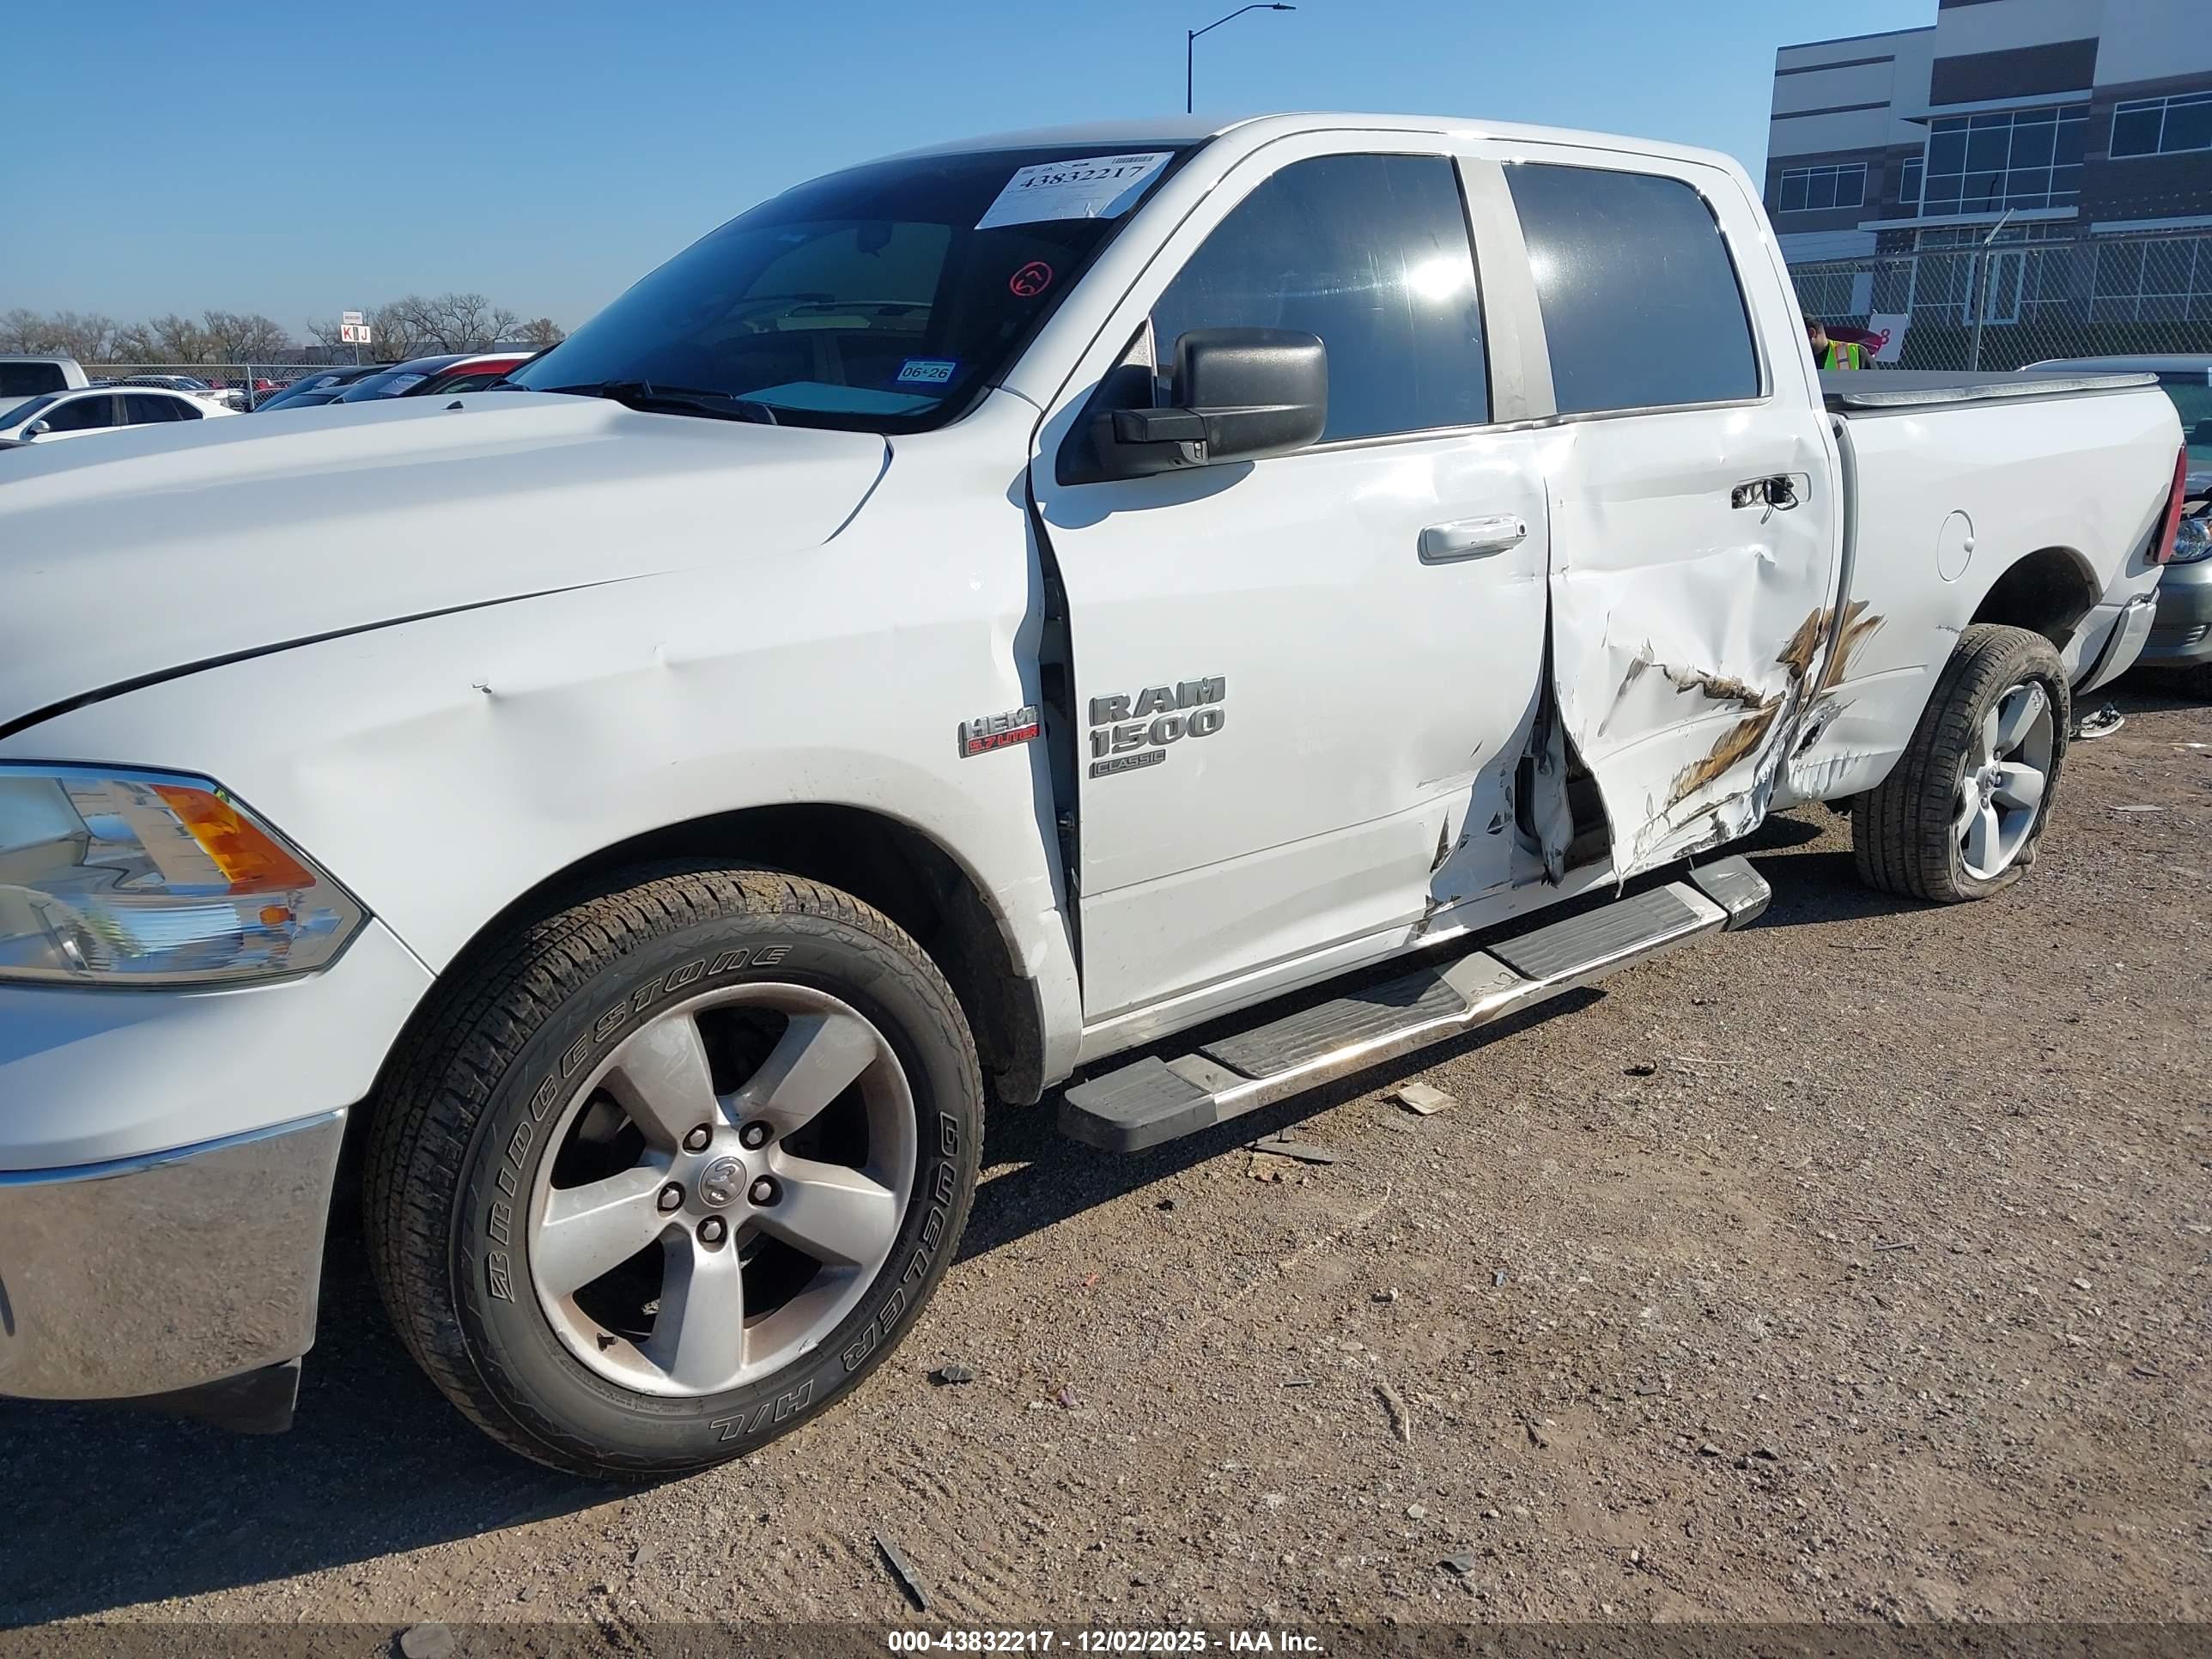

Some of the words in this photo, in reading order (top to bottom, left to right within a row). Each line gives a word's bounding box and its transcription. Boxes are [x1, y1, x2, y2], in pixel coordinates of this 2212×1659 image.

[1019, 165, 1146, 189] 43832217
[343, 326, 353, 339] K
[361, 328, 368, 340] J
[1089, 674, 1226, 726] RAM
[968, 735, 997, 753] 5.7
[998, 726, 1039, 746] LITER
[1090, 705, 1226, 758] 1500
[1092, 750, 1165, 776] CLASSIC
[483, 945, 794, 1304] BRIDGESTONE
[839, 1110, 961, 1373] DUELER
